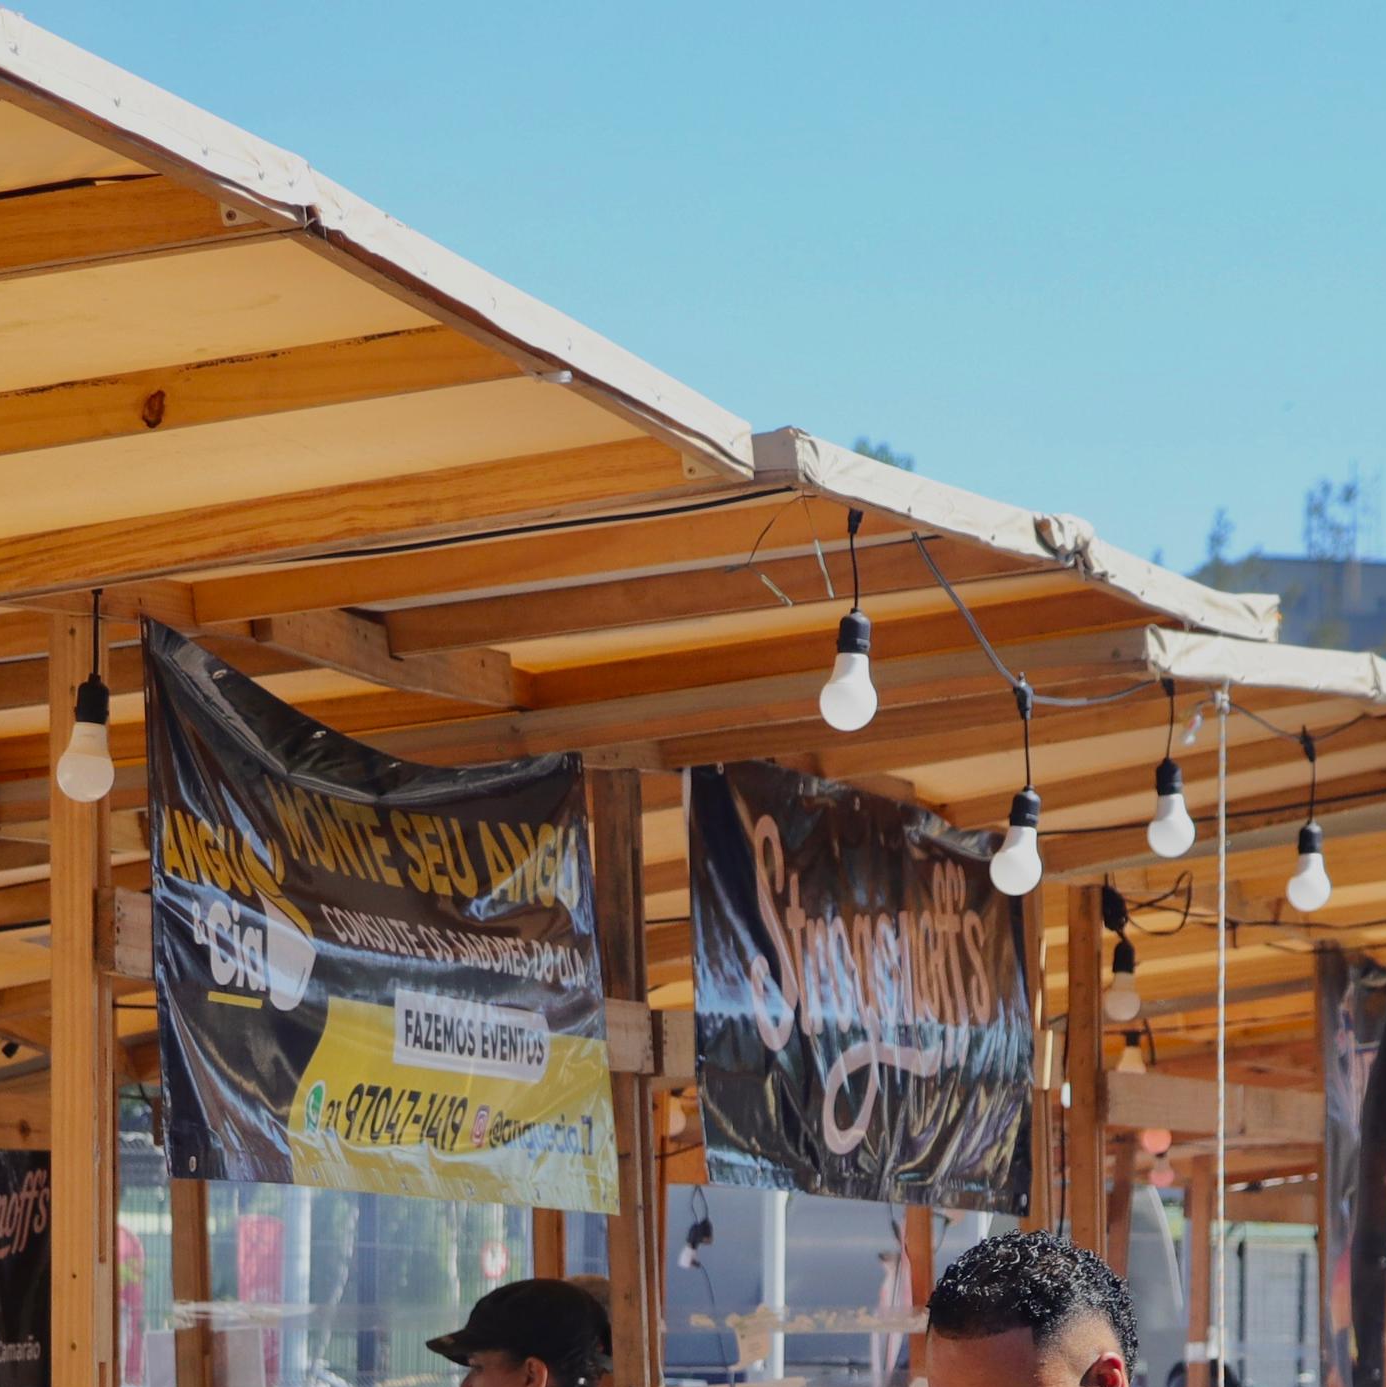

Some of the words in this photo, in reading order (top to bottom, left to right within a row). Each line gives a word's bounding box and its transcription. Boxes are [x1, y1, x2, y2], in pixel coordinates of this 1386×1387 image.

[161, 805, 255, 897] ANGU
[265, 775, 402, 889] MONTE
[388, 808, 481, 899] SEU
[476, 819, 583, 910] ANGU
[320, 903, 426, 959] CONSULTE
[416, 925, 455, 964] OS
[450, 930, 537, 979] SABORES
[404, 1008, 477, 1058] FAZEMOS
[480, 1021, 545, 1067] EVENTOS
[344, 1082, 470, 1153] 97047-1419
